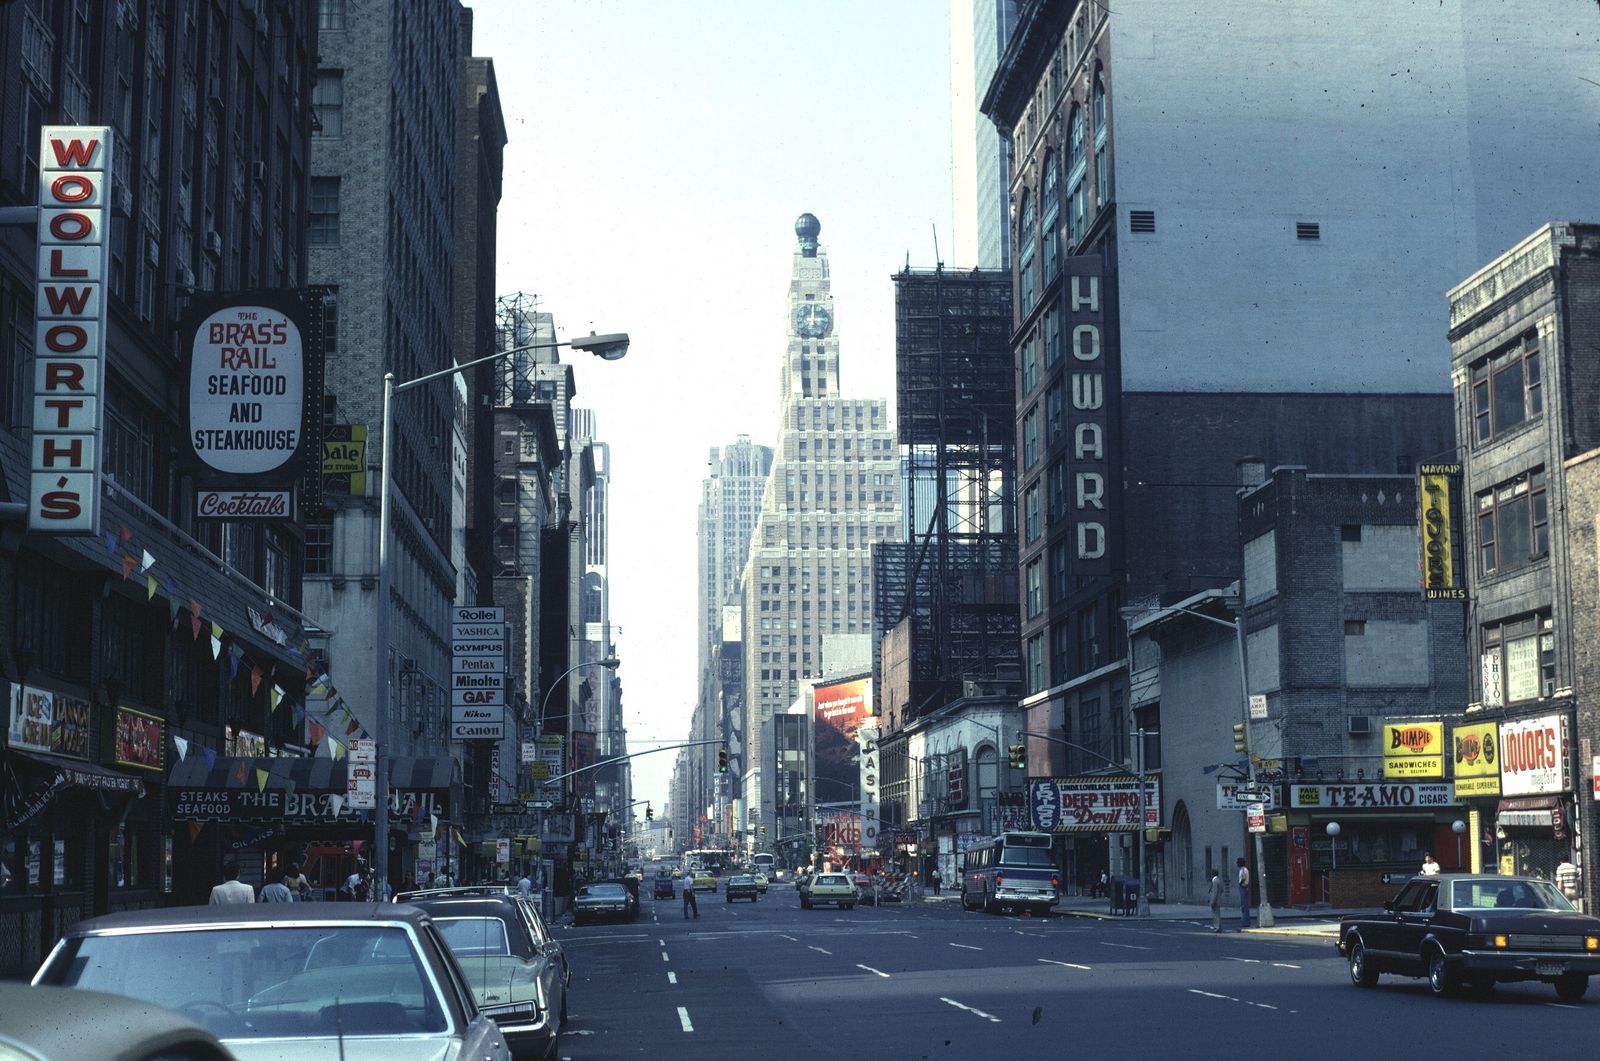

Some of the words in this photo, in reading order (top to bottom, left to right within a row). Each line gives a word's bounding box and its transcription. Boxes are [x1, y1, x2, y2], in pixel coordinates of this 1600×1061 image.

[238, 312, 258, 321] THE
[40, 138, 99, 520] WOOLWORTH'S
[208, 318, 287, 346] BRASS
[220, 348, 276, 370] RAIL
[208, 376, 286, 396] SEAFOOD
[229, 402, 261, 424] AND
[1071, 276, 1106, 560] HOWARD
[194, 430, 296, 451] STEAKHOUSE
[1421, 464, 1460, 475] MAYFAIR
[199, 493, 286, 516] Cocktails
[1427, 589, 1466, 600] WINES
[459, 609, 497, 621] Rollei
[457, 627, 500, 637] YASHICA
[454, 644, 503, 653] OLYMPUS
[461, 659, 495, 671] Pentax
[455, 675, 501, 688] Minolta
[462, 691, 495, 704] GAF
[463, 710, 491, 719] Nikon
[455, 725, 500, 737] Canon
[1391, 727, 1431, 750] BLIMPIE
[350, 741, 358, 750] NO
[1501, 728, 1556, 776] LIQUORS
[1561, 718, 1570, 788] LIQUORS
[1388, 761, 1437, 769] SANDWICHES
[349, 781, 357, 790] NO
[179, 791, 229, 803] STEAKS
[1062, 793, 1099, 808] DEEP
[1100, 792, 1155, 807] THROT
[1326, 785, 1415, 807] TE-AMO
[1418, 794, 1448, 804] CIGARS
[175, 803, 231, 815] SEAFOOD
[237, 793, 279, 808] THE
[284, 793, 372, 816] BRAS
